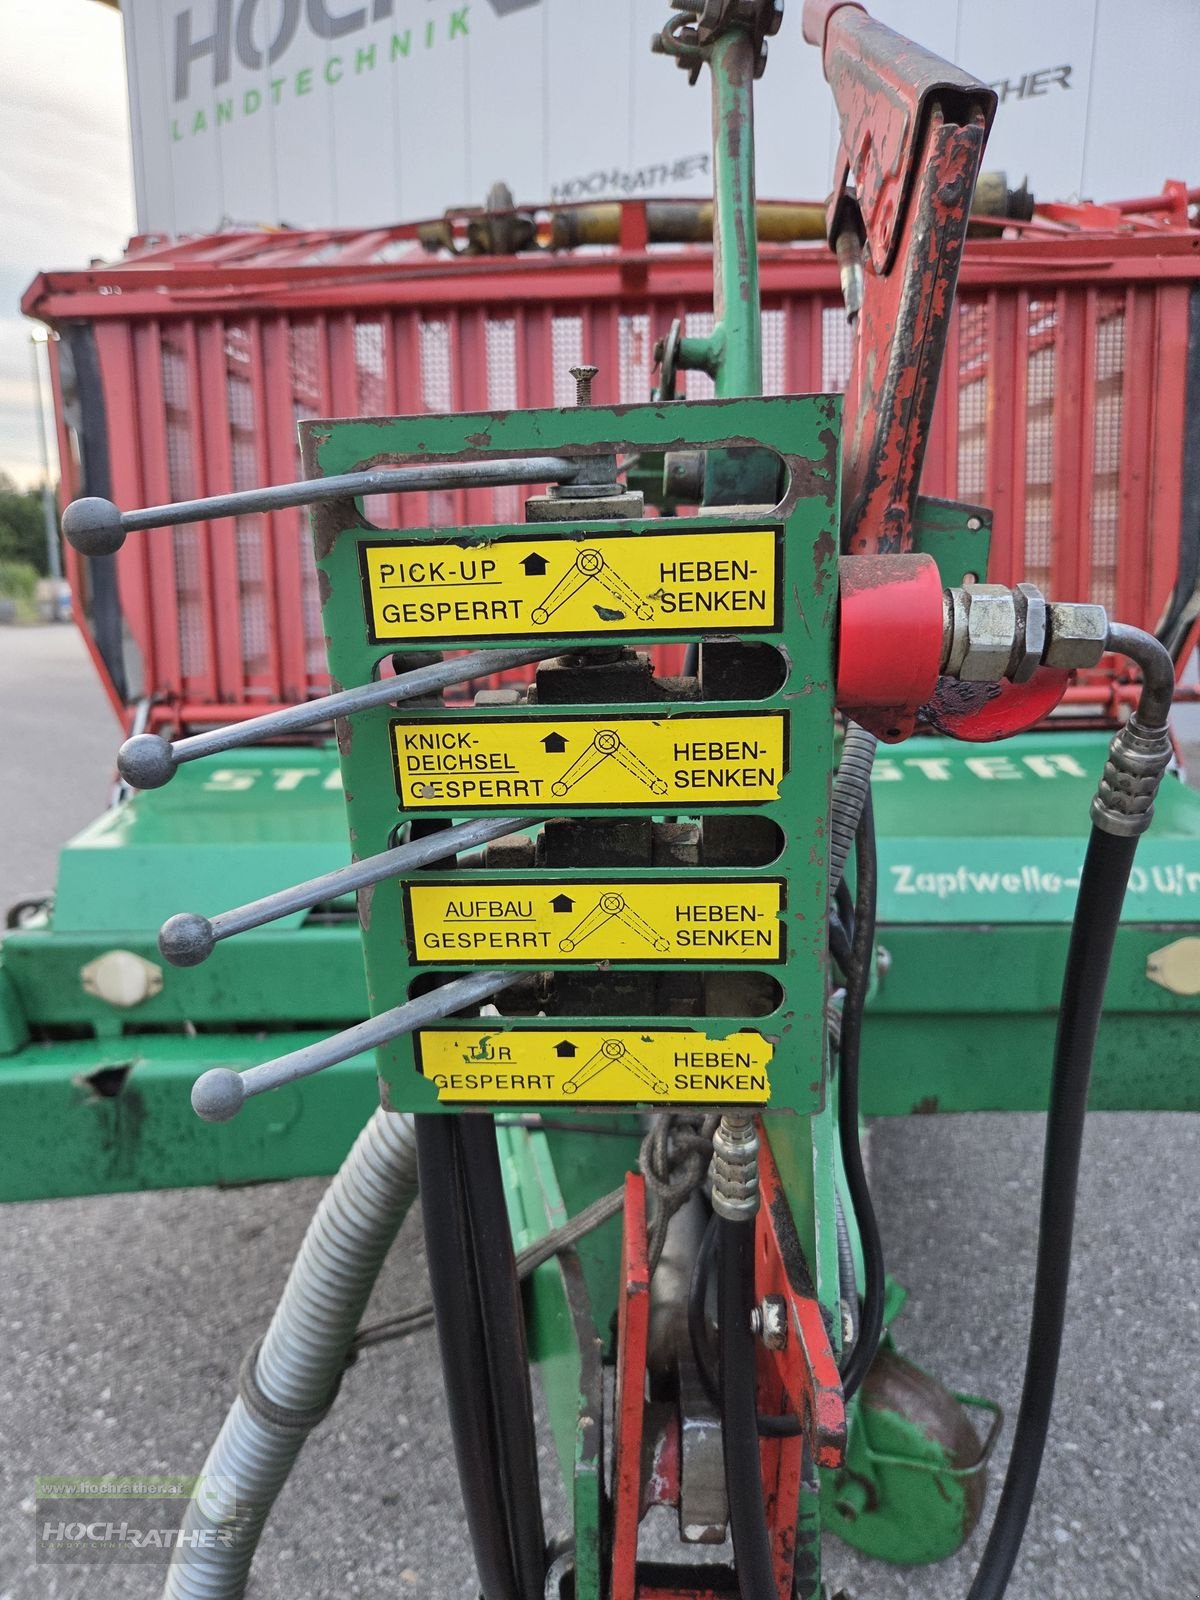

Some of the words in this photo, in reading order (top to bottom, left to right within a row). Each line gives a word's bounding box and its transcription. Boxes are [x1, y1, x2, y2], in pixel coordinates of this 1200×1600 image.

[171, 7, 470, 142] LANDTECHNIK
[990, 64, 1072, 104] HER
[380, 559, 497, 584] PICK-UP
[660, 559, 758, 583] HEBEN-
[382, 599, 523, 624] GESPERRT
[661, 590, 766, 613] SENKEN
[404, 731, 480, 751] KNICK-
[674, 741, 767, 762] HEBEN-
[406, 752, 516, 772] DEICHSEL
[674, 767, 775, 788] SENKEN
[410, 779, 544, 800] GESPERRT
[445, 900, 533, 918] AUFBAU
[675, 904, 765, 922] HEBEN-
[423, 931, 552, 949] GESPERRT
[676, 929, 772, 947] SENKEN
[674, 1052, 758, 1069] HEBEN-
[432, 1074, 555, 1090] GESPERRT
[674, 1074, 765, 1091] SENKEN
